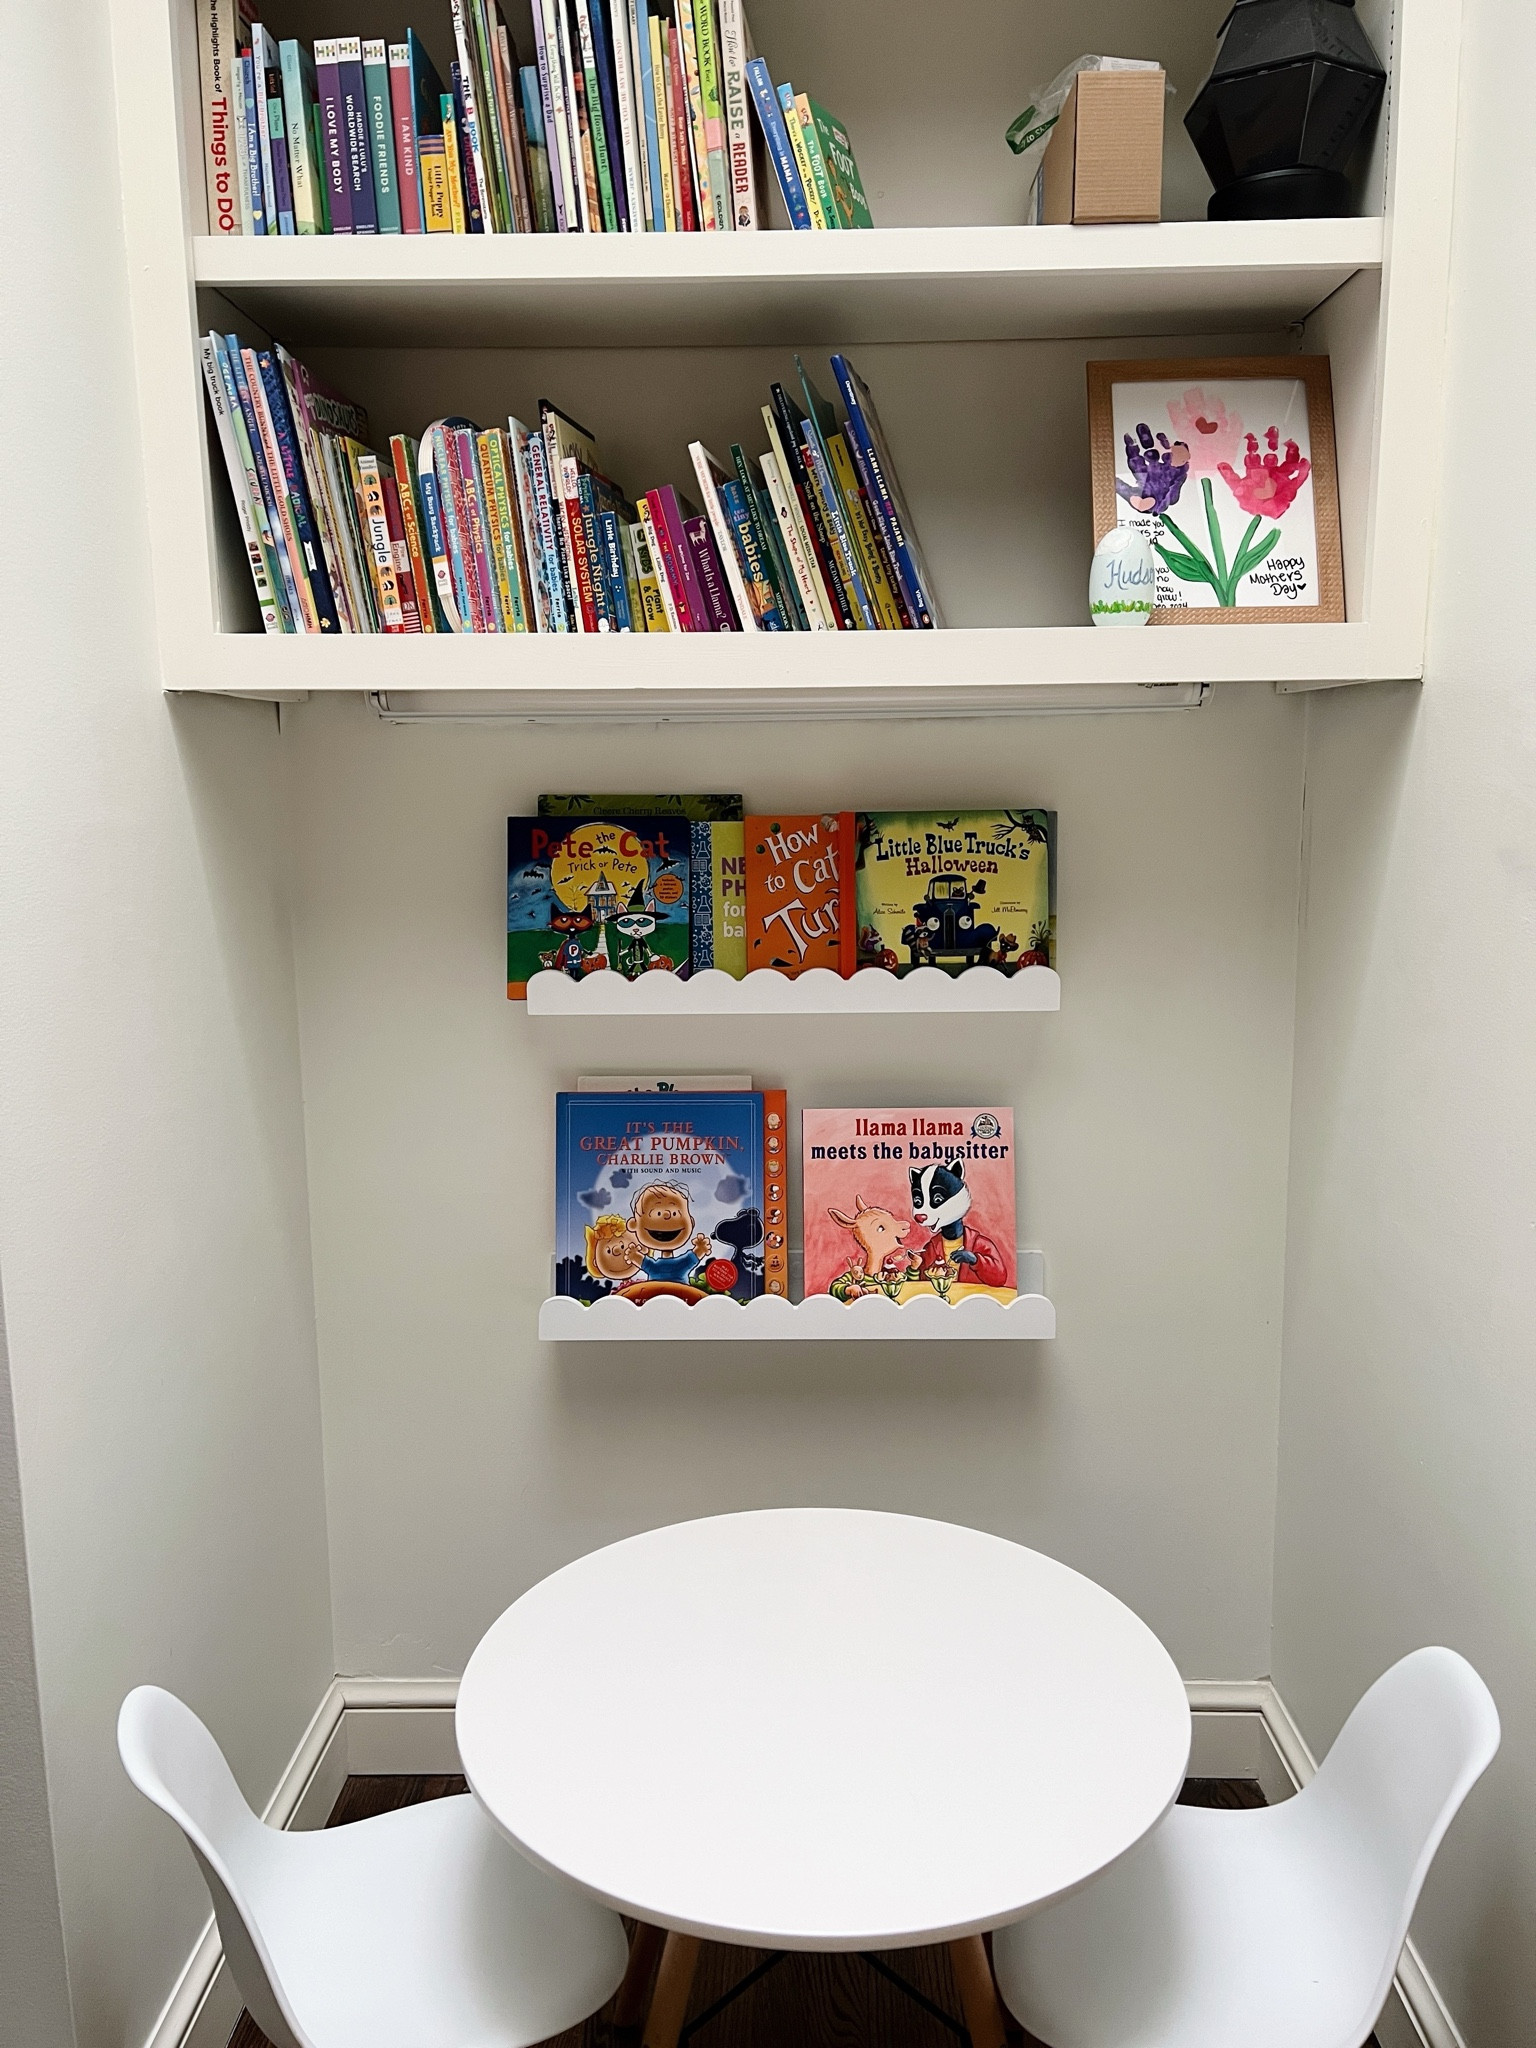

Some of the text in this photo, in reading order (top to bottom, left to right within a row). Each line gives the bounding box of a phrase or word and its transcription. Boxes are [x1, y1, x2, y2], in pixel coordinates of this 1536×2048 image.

[699, 5, 712, 66] WORD BOOK
[725, 30, 738, 54] How
[210, 13, 223, 93] Highlights Book of
[538, 46, 547, 61] How
[540, 63, 547, 71] to
[540, 73, 551, 102] Surprise
[727, 71, 744, 130] RAISE
[291, 123, 299, 135] No
[327, 105, 337, 135] LOVE
[356, 112, 364, 140] HADDIE
[463, 76, 479, 153] THE B BOOK
[588, 77, 608, 169] The Big Honey Hunt
[248, 129, 256, 142] Am
[329, 138, 339, 157] MY
[345, 95, 361, 191] WORLDWIDE SEARCH
[373, 96, 389, 193] FOODIE FRIENDS
[402, 124, 411, 143] AM
[211, 97, 234, 230] Things to DO
[248, 150, 258, 163] Big
[293, 137, 302, 163] Matter
[359, 148, 368, 173] LULU'S
[404, 147, 413, 176] KIND
[250, 164, 260, 196] Brother!
[332, 160, 343, 193] BODY
[446, 129, 460, 208] Are You My Mother?
[733, 142, 749, 193] READER
[779, 156, 793, 183] MAMA
[807, 140, 828, 198] The FOOT BOOK
[434, 165, 444, 219] Little Puppy
[203, 348, 226, 416] My big truck book
[490, 439, 503, 484] OPTICAL
[531, 445, 545, 492] GENERAL
[245, 467, 263, 507] SATURDAY
[424, 482, 432, 495] My
[435, 435, 460, 554] NUCLEAR PHYSICS for babies
[867, 448, 905, 547] LLAMA LLAMA PAJAMA
[400, 482, 420, 558] ABCs of Science
[426, 497, 436, 514] Busy
[464, 478, 484, 554] ABCs of Physics
[480, 443, 494, 497] QUANTUM
[488, 499, 501, 541] PHYSICS
[497, 556, 506, 582] babies
[496, 486, 510, 528] PHYSICS
[538, 495, 553, 550] RELATIVITY
[372, 519, 390, 563] Jungle
[605, 519, 619, 578] Little Birthday
[738, 520, 765, 583] babies
[831, 512, 856, 576] Little Blue Truck
[392, 543, 404, 571] Engine
[505, 545, 515, 571] babies
[548, 554, 556, 565] for
[571, 517, 592, 603] SOLAR SYSTEM
[582, 513, 605, 607] Jungle Night
[699, 548, 711, 570] What
[1267, 557, 1305, 570] Happy
[550, 567, 559, 592] babies
[704, 572, 714, 581] Is
[1249, 570, 1302, 584] Mothers
[1270, 583, 1297, 599] Day
[646, 594, 657, 621] Grow
[652, 589, 663, 614] Plant
[710, 588, 726, 619] Llama?
[1157, 591, 1182, 602] grow!
[531, 829, 670, 859] Pete the Cat
[765, 824, 818, 866] How
[875, 832, 1030, 862] Little Blue Truck's
[568, 861, 596, 873] Trick
[612, 858, 637, 874] Pete
[765, 875, 785, 893] to
[792, 849, 839, 894] Cat
[906, 856, 998, 876] Halloween
[626, 1122, 694, 1134] IT'S THE
[855, 1118, 964, 1136] llama llama
[580, 1136, 744, 1152] GREAT PUMPKIN,
[596, 1153, 725, 1165] CHARLIE BROWN
[811, 1141, 1008, 1164] meets the babysitter
